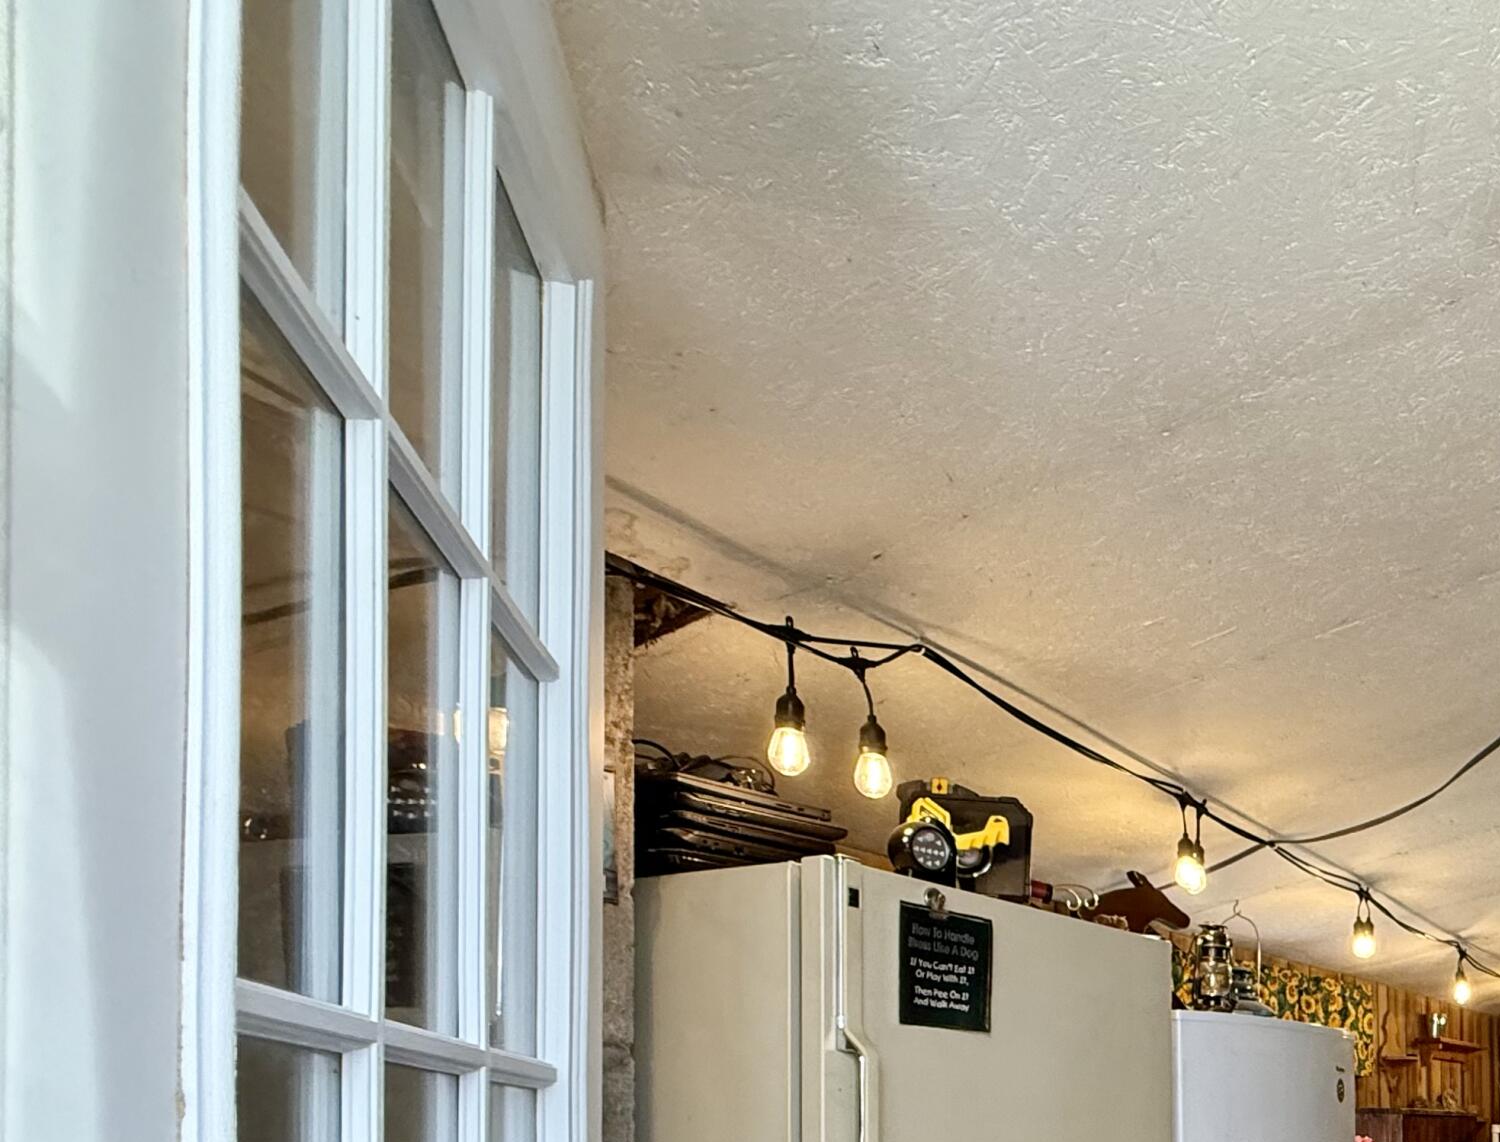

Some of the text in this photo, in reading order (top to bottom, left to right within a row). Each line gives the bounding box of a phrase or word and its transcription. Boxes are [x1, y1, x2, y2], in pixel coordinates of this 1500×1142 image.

[911, 922, 975, 945] How To Handle
[951, 945, 959, 956] A
[960, 946, 979, 962] Dog
[918, 958, 932, 969] You
[932, 961, 953, 971] Can't
[954, 964, 967, 974] Eat
[915, 969, 925, 978] Or
[926, 971, 941, 983] Play
[942, 974, 959, 983] With
[914, 985, 933, 997] Then
[933, 988, 949, 999] Pee
[949, 990, 961, 1000] On
[913, 997, 970, 1013] And Walk Away
